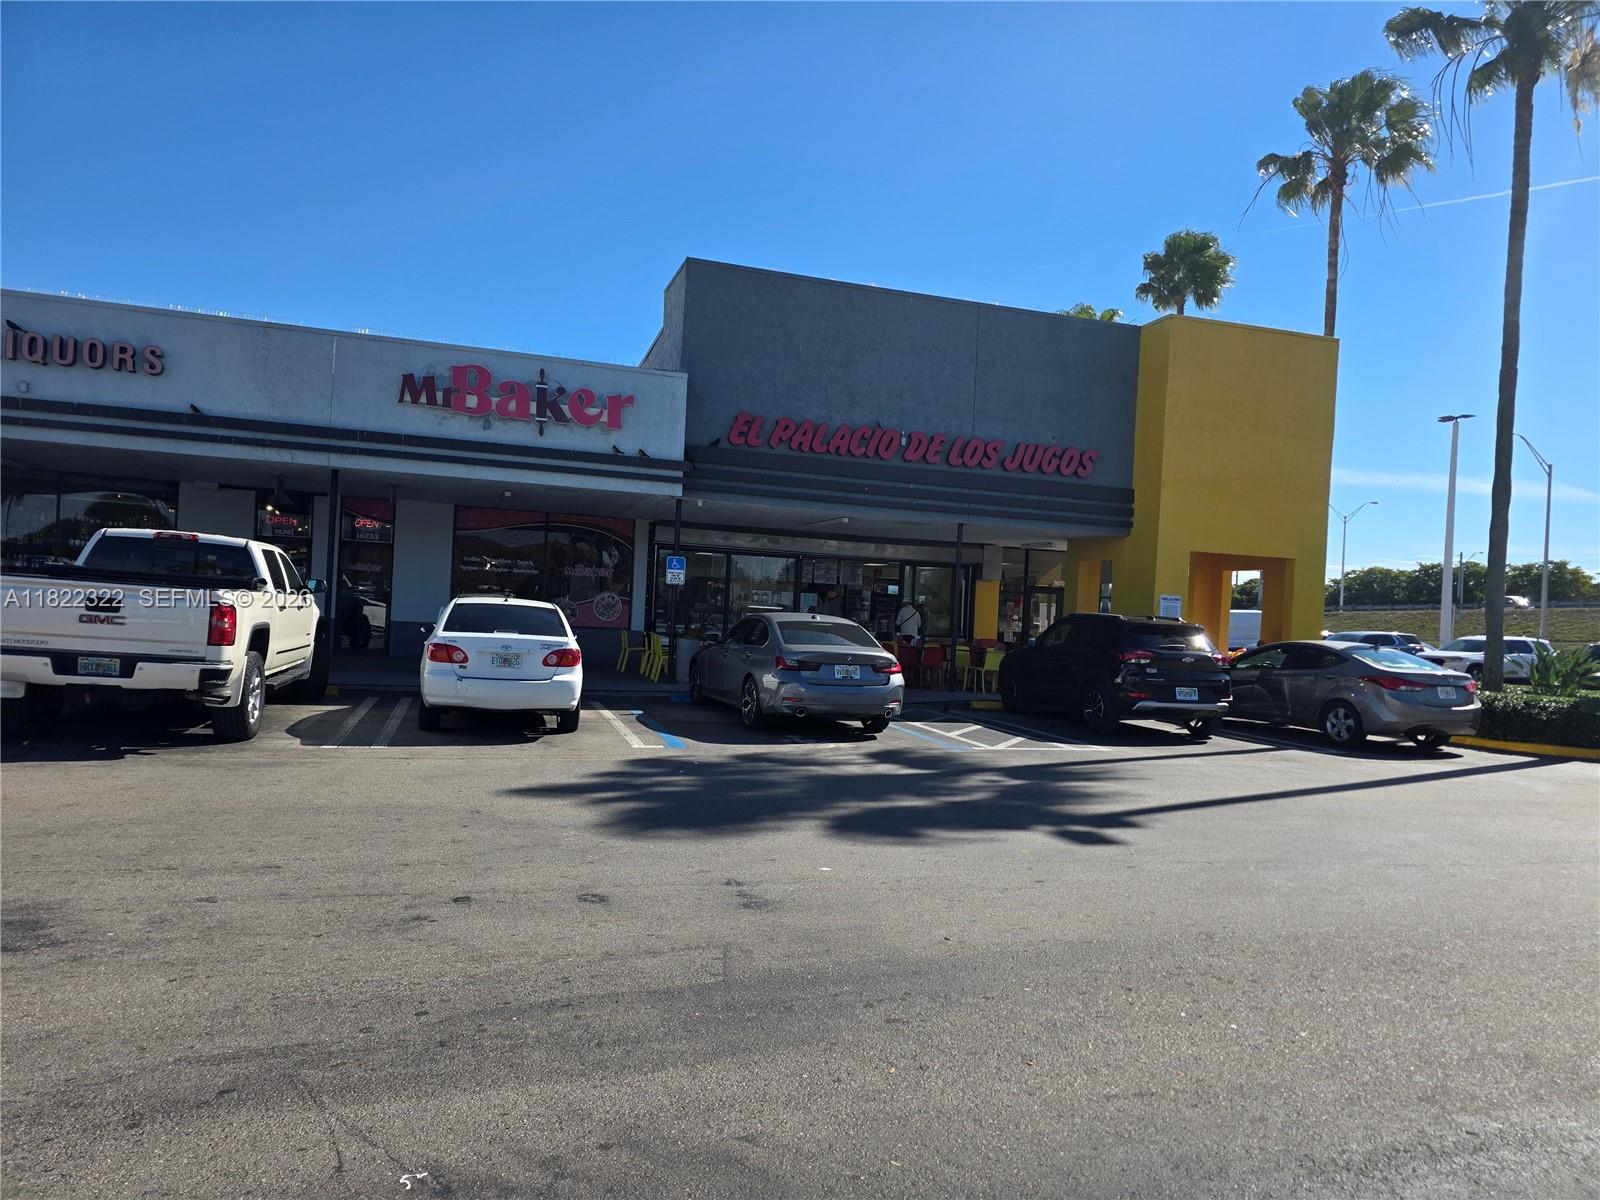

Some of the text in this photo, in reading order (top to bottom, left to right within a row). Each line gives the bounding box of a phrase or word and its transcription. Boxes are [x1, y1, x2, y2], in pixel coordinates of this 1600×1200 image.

[450, 364, 635, 436] Baker
[728, 412, 1099, 479] EL PALACIO DE LOS JUGOS
[265, 515, 298, 526] OPEN
[354, 518, 380, 528] OPEN
[79, 613, 128, 626] GMC
